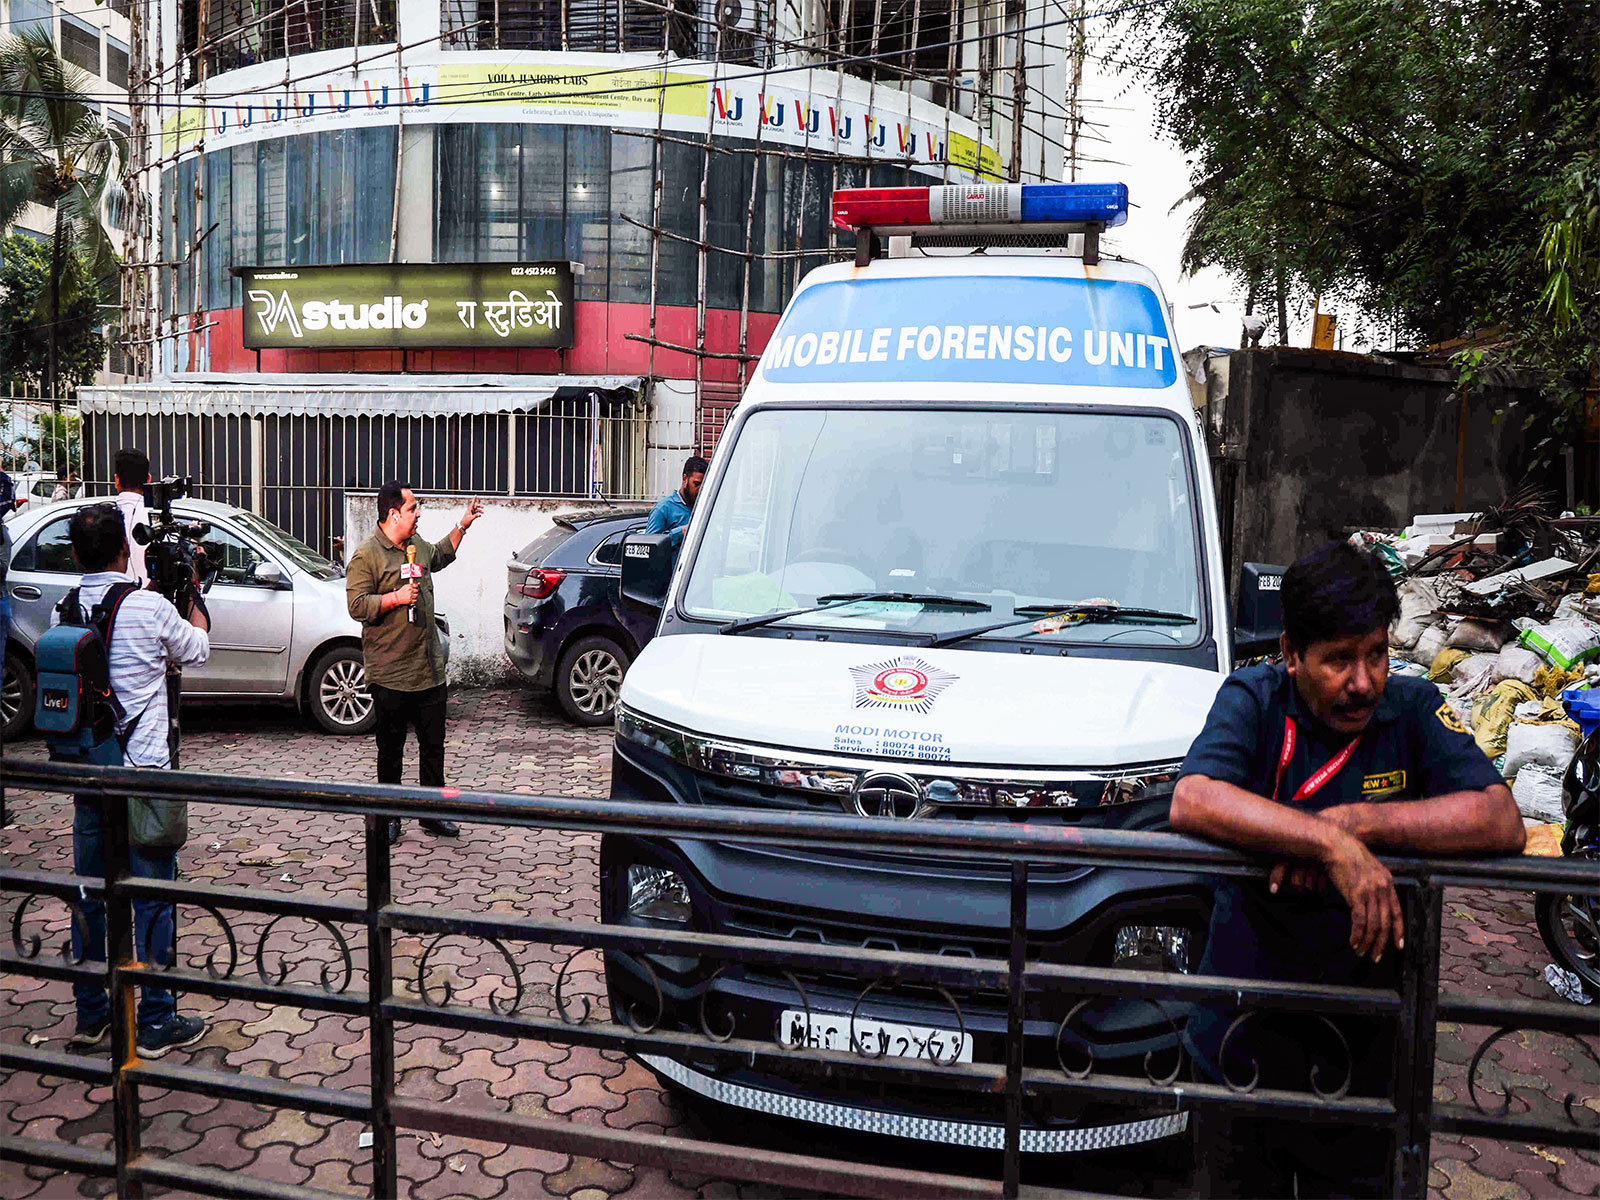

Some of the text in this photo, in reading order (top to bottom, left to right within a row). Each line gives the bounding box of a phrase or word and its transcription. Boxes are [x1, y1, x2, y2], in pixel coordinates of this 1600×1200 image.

[563, 74, 588, 86] LABS
[456, 289, 563, 338] रा स्टुडिओ
[765, 325, 1169, 371] MOBILE FORENSIC UNIT
[835, 724, 943, 743] MODI MOTOR
[833, 744, 873, 754] Service
[882, 748, 915, 758] 80075
[918, 752, 951, 762] 80075
[834, 736, 862, 745] Sales
[882, 741, 915, 750] 80074
[918, 744, 951, 754] 80074
